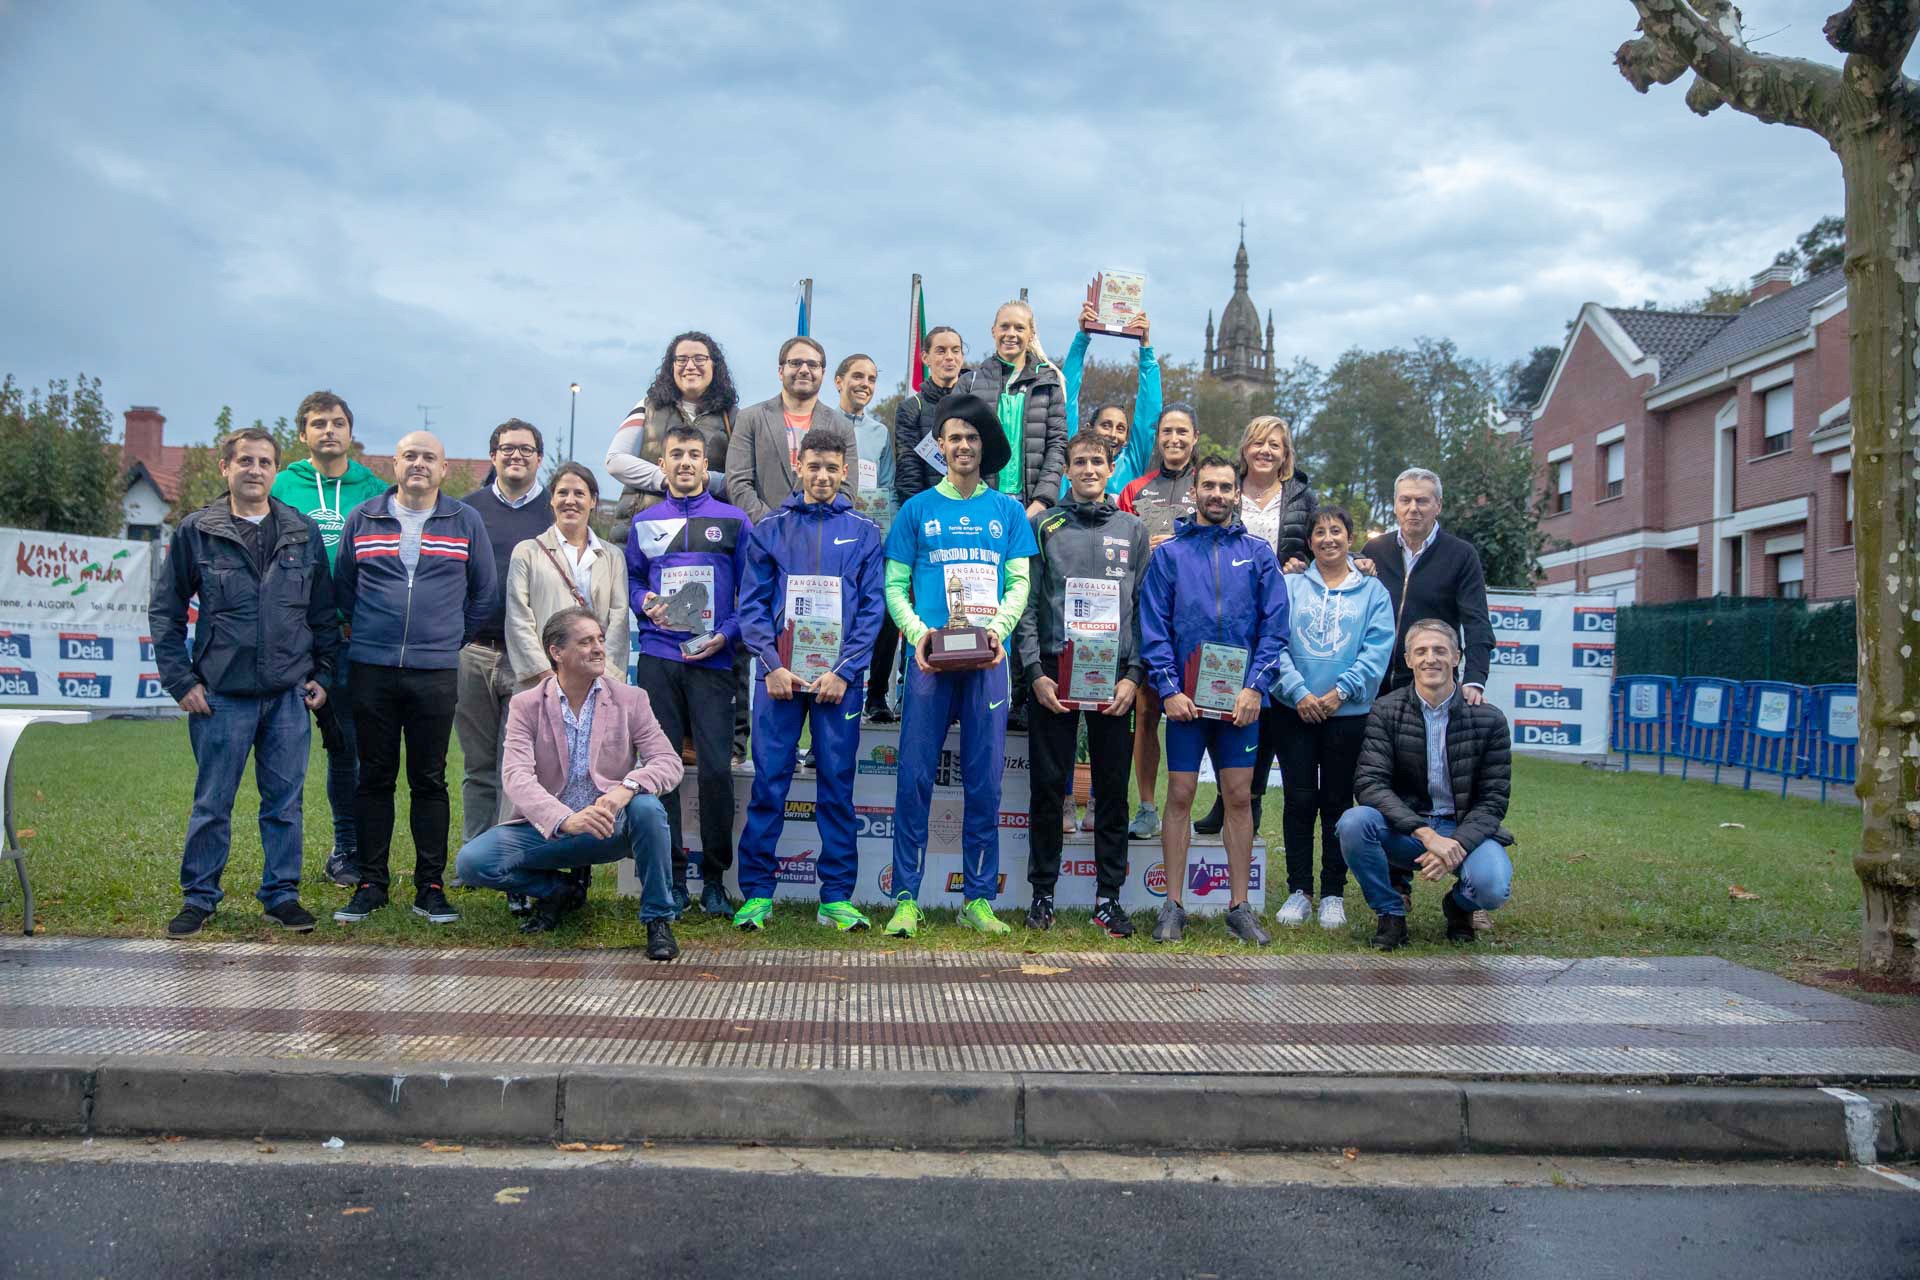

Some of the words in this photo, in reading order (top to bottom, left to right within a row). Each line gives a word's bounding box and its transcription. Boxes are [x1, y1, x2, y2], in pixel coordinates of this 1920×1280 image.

[965, 606, 995, 615] EROSKI
[68, 640, 104, 659] Deia
[66, 680, 101, 697] Deia
[1525, 690, 1570, 708] Deia
[1524, 726, 1569, 744] Deia
[775, 873, 814, 881] Pinturas
